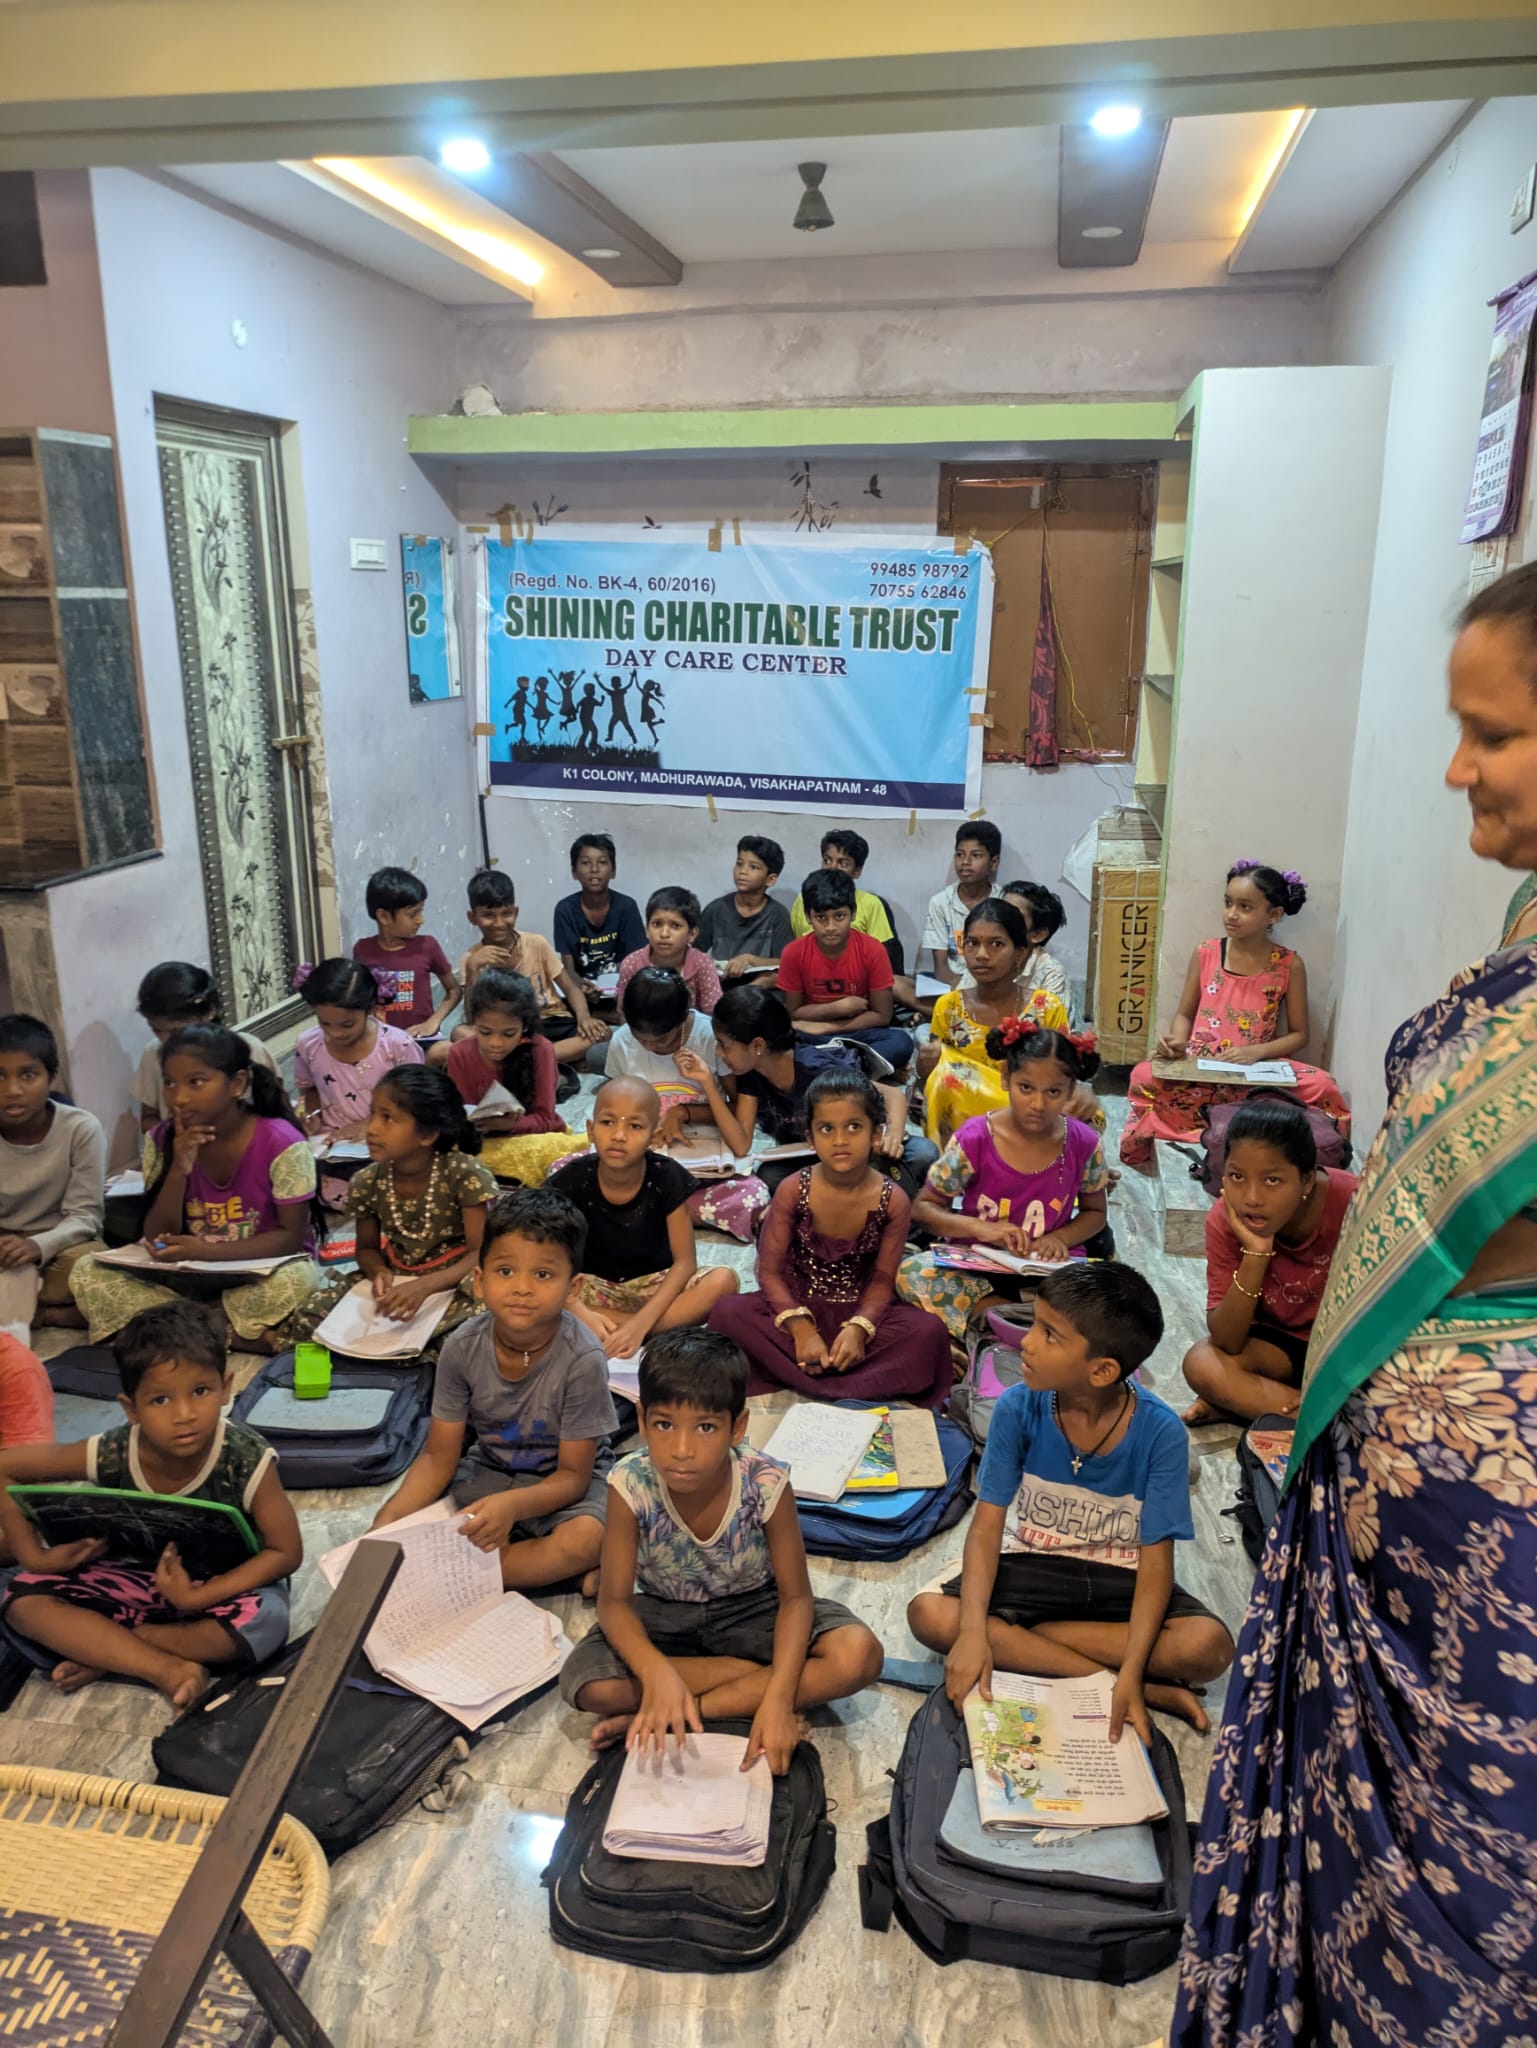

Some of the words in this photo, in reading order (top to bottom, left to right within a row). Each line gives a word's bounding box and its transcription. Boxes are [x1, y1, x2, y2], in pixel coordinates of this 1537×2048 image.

[509, 571, 562, 591] (Regd.
[566, 574, 592, 591] No.
[598, 574, 643, 594] BK-4,
[648, 576, 716, 595] 60/2016)
[870, 562, 917, 577] 99485
[922, 563, 969, 578] 98792
[870, 583, 915, 598] 70755
[921, 584, 967, 599] 62846
[505, 595, 634, 641] SHINING
[644, 600, 840, 646] CHARITABLE
[849, 607, 960, 653] TRUST
[605, 648, 656, 669] DAY
[664, 650, 734, 671] CARE
[742, 654, 848, 676] CENTER
[562, 767, 579, 780] K1
[581, 769, 637, 785] COLONY,
[640, 772, 746, 790] MADHURAWADA,
[749, 778, 861, 794] VISAKHAPATNAM
[872, 784, 887, 796] 48
[1117, 903, 1149, 1034] GRANICER
[1018, 1485, 1139, 1544] SHIO
